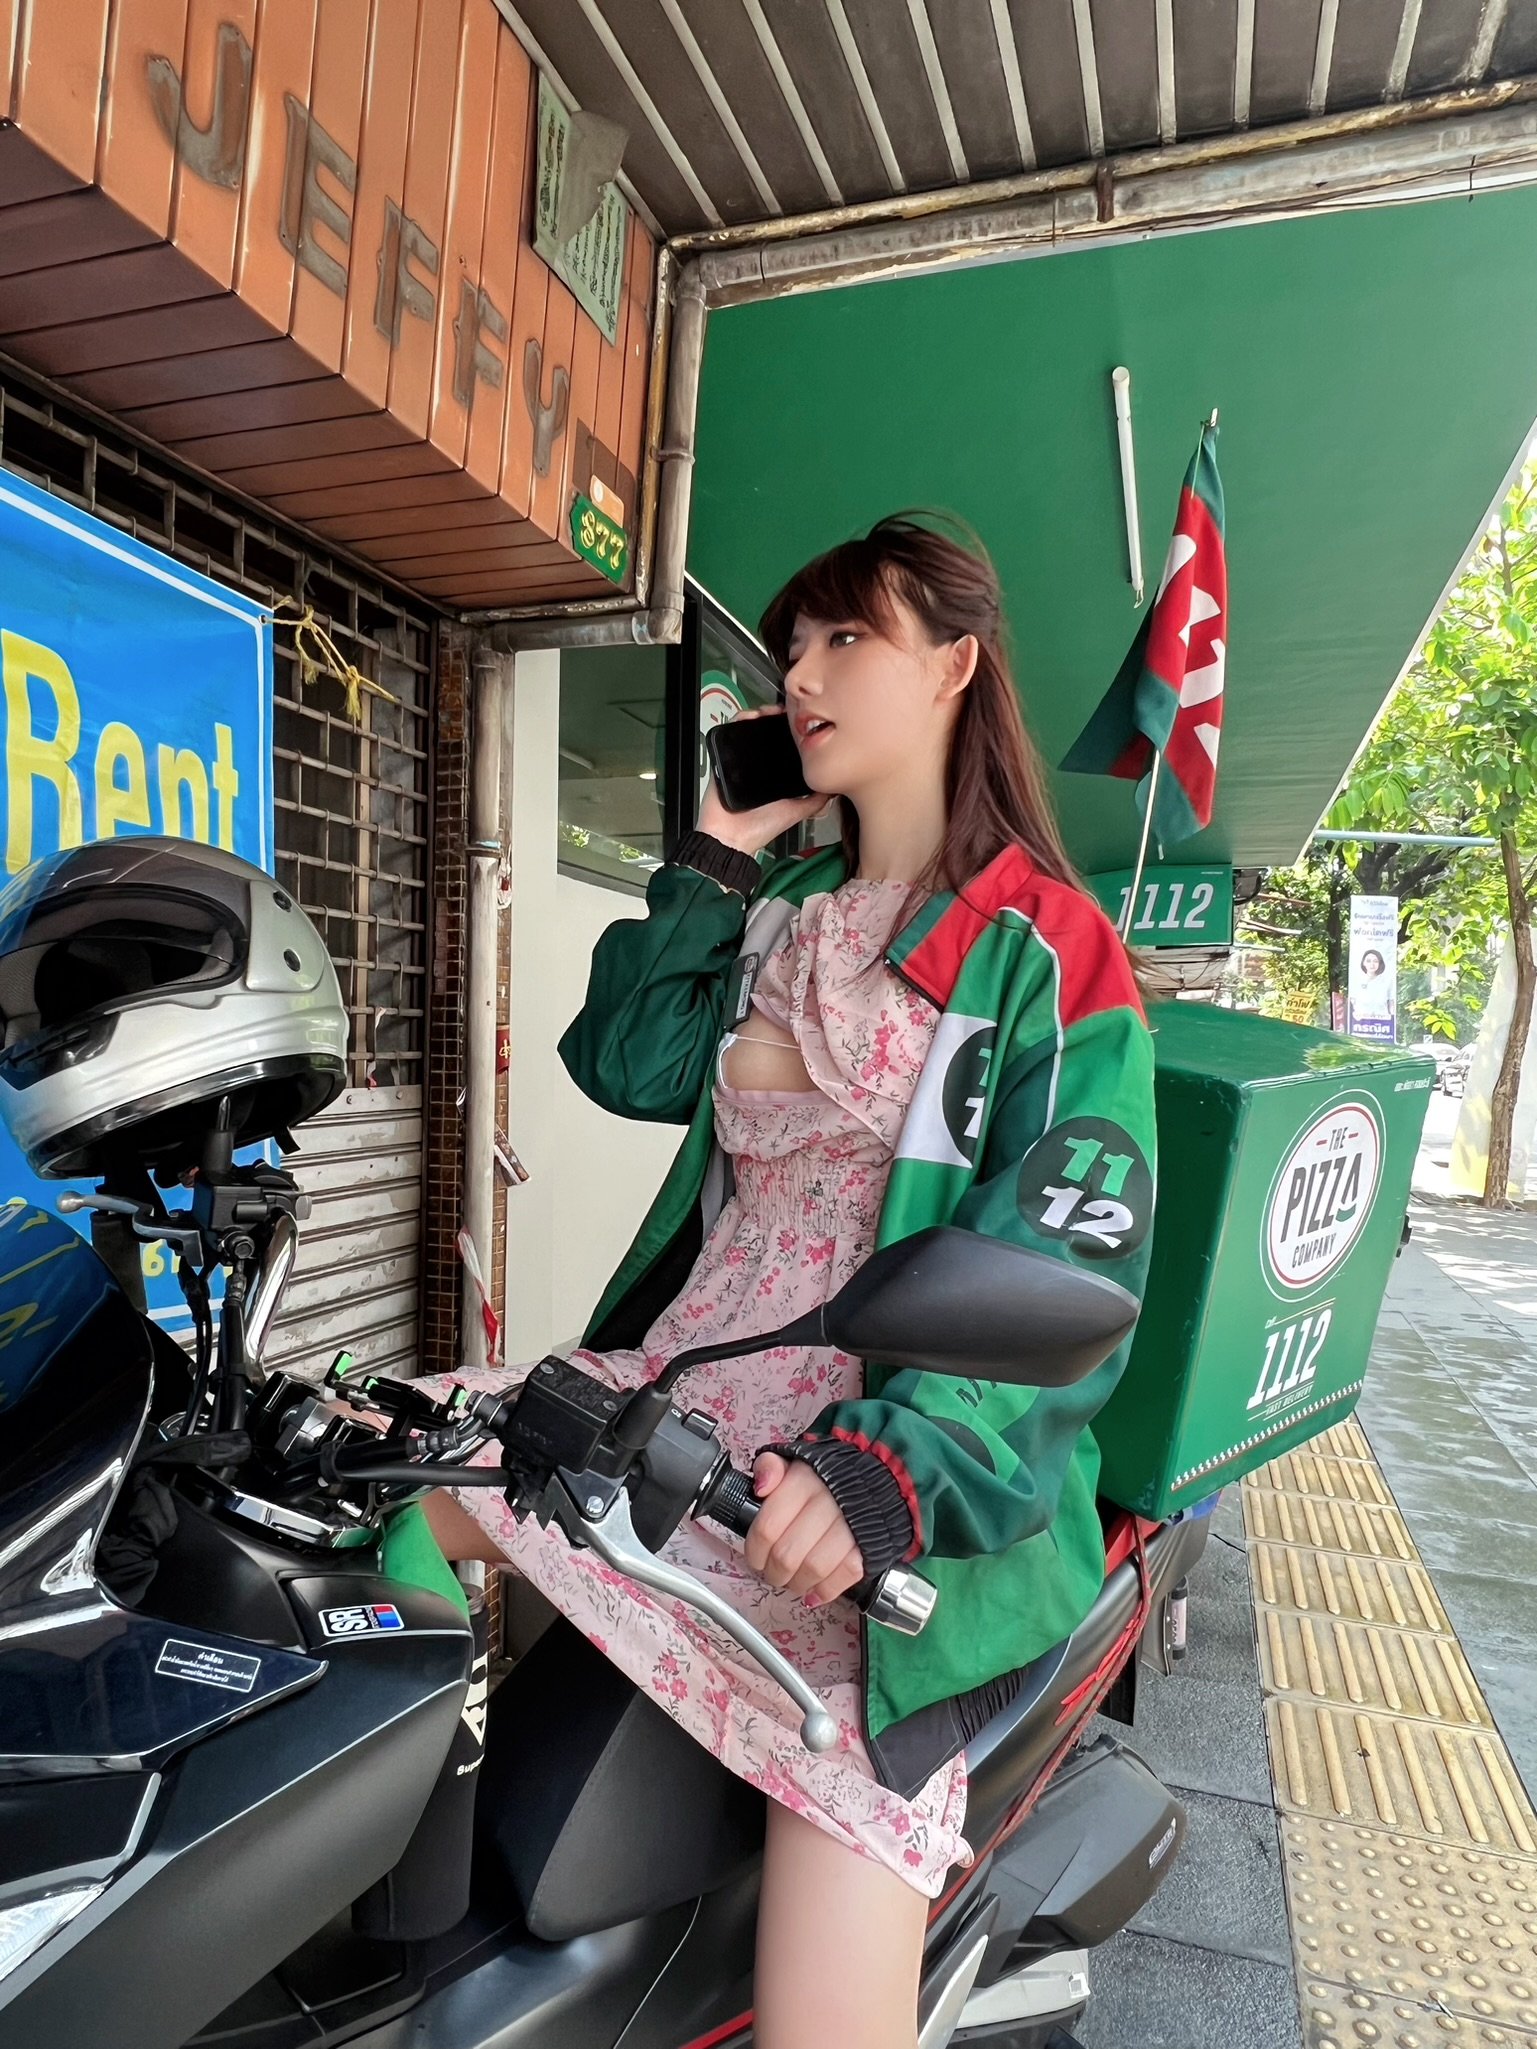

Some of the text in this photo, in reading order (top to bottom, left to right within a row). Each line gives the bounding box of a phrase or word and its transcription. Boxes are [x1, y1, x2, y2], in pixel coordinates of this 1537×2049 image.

[147, 21, 570, 478] JEFFY
[580, 510, 624, 570] 877
[1, 628, 240, 875] Rent
[1115, 883, 1214, 931] 1112
[1061, 1136, 1135, 1197] 11
[1329, 1127, 1349, 1151] THE
[1040, 1185, 1134, 1249] 12
[1280, 1152, 1363, 1243] PIZZA
[1292, 1233, 1337, 1269] COMPANY
[1246, 1308, 1332, 1411] 1112
[330, 1607, 370, 1632] SR
